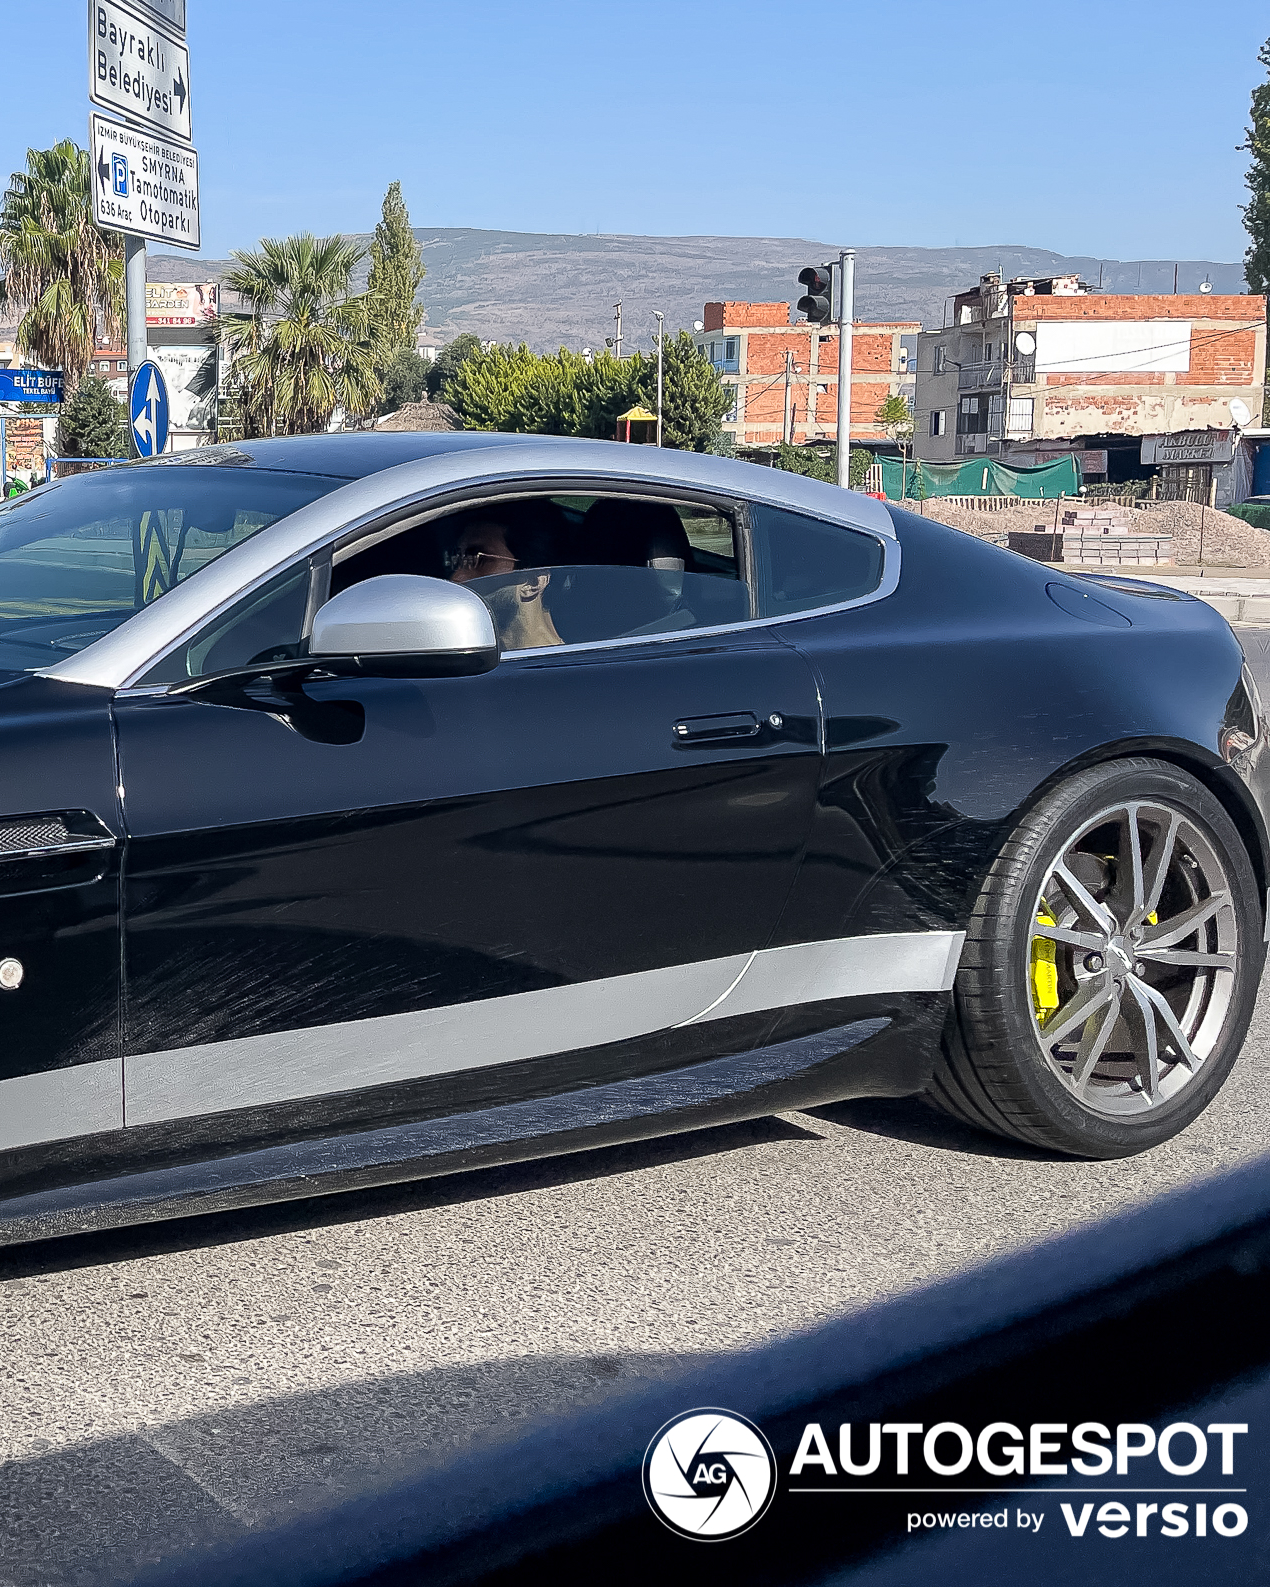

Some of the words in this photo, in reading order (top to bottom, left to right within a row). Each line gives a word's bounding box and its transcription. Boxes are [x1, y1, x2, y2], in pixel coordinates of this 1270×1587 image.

[98, 6, 164, 72] Bayraklı
[98, 49, 172, 115] Belediyesi
[98, 122, 117, 141] İZMİR
[142, 156, 185, 185] SMYRNA
[130, 170, 196, 210] Tamotomatik
[101, 199, 116, 217] 636
[118, 204, 132, 223] Araç
[140, 200, 190, 233] Otoparkı
[14, 374, 36, 387] ELİT
